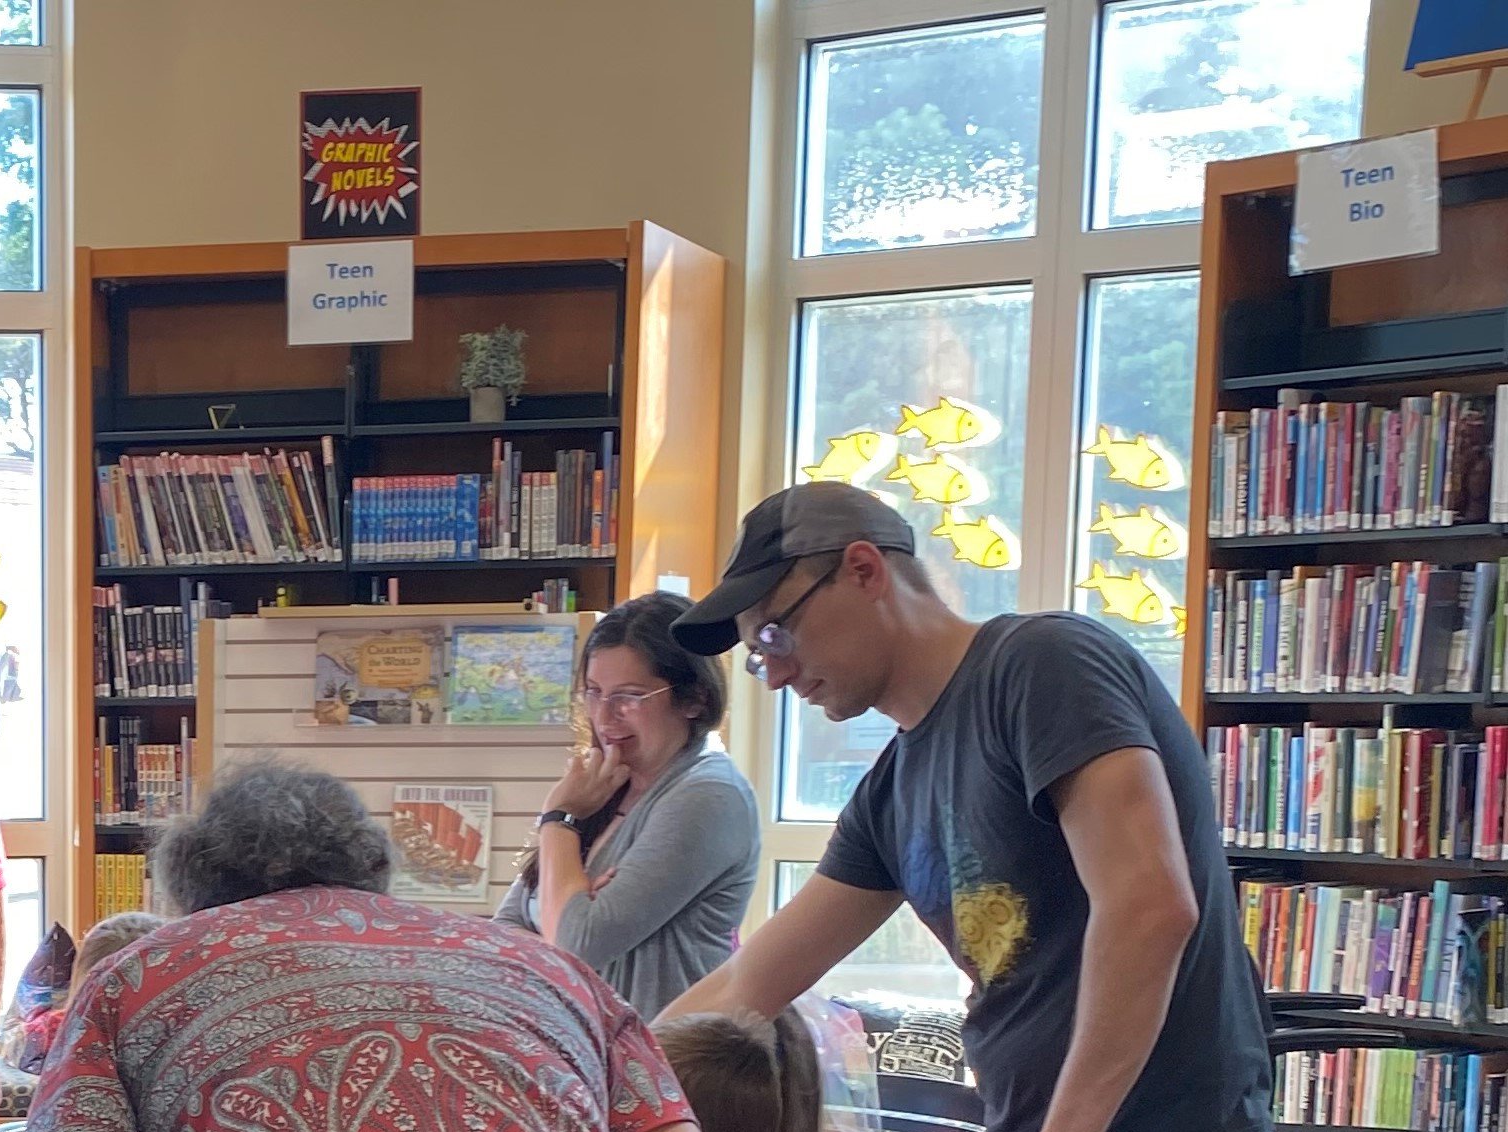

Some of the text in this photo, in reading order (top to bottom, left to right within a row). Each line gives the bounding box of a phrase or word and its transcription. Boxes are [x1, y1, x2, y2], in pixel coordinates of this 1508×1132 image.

[321, 141, 395, 163] GRAPHIC
[331, 165, 395, 192] NOVELS
[1341, 164, 1395, 188] Teen
[1349, 200, 1384, 222] Bio
[326, 263, 374, 280] Teen
[312, 291, 388, 312] Graphic
